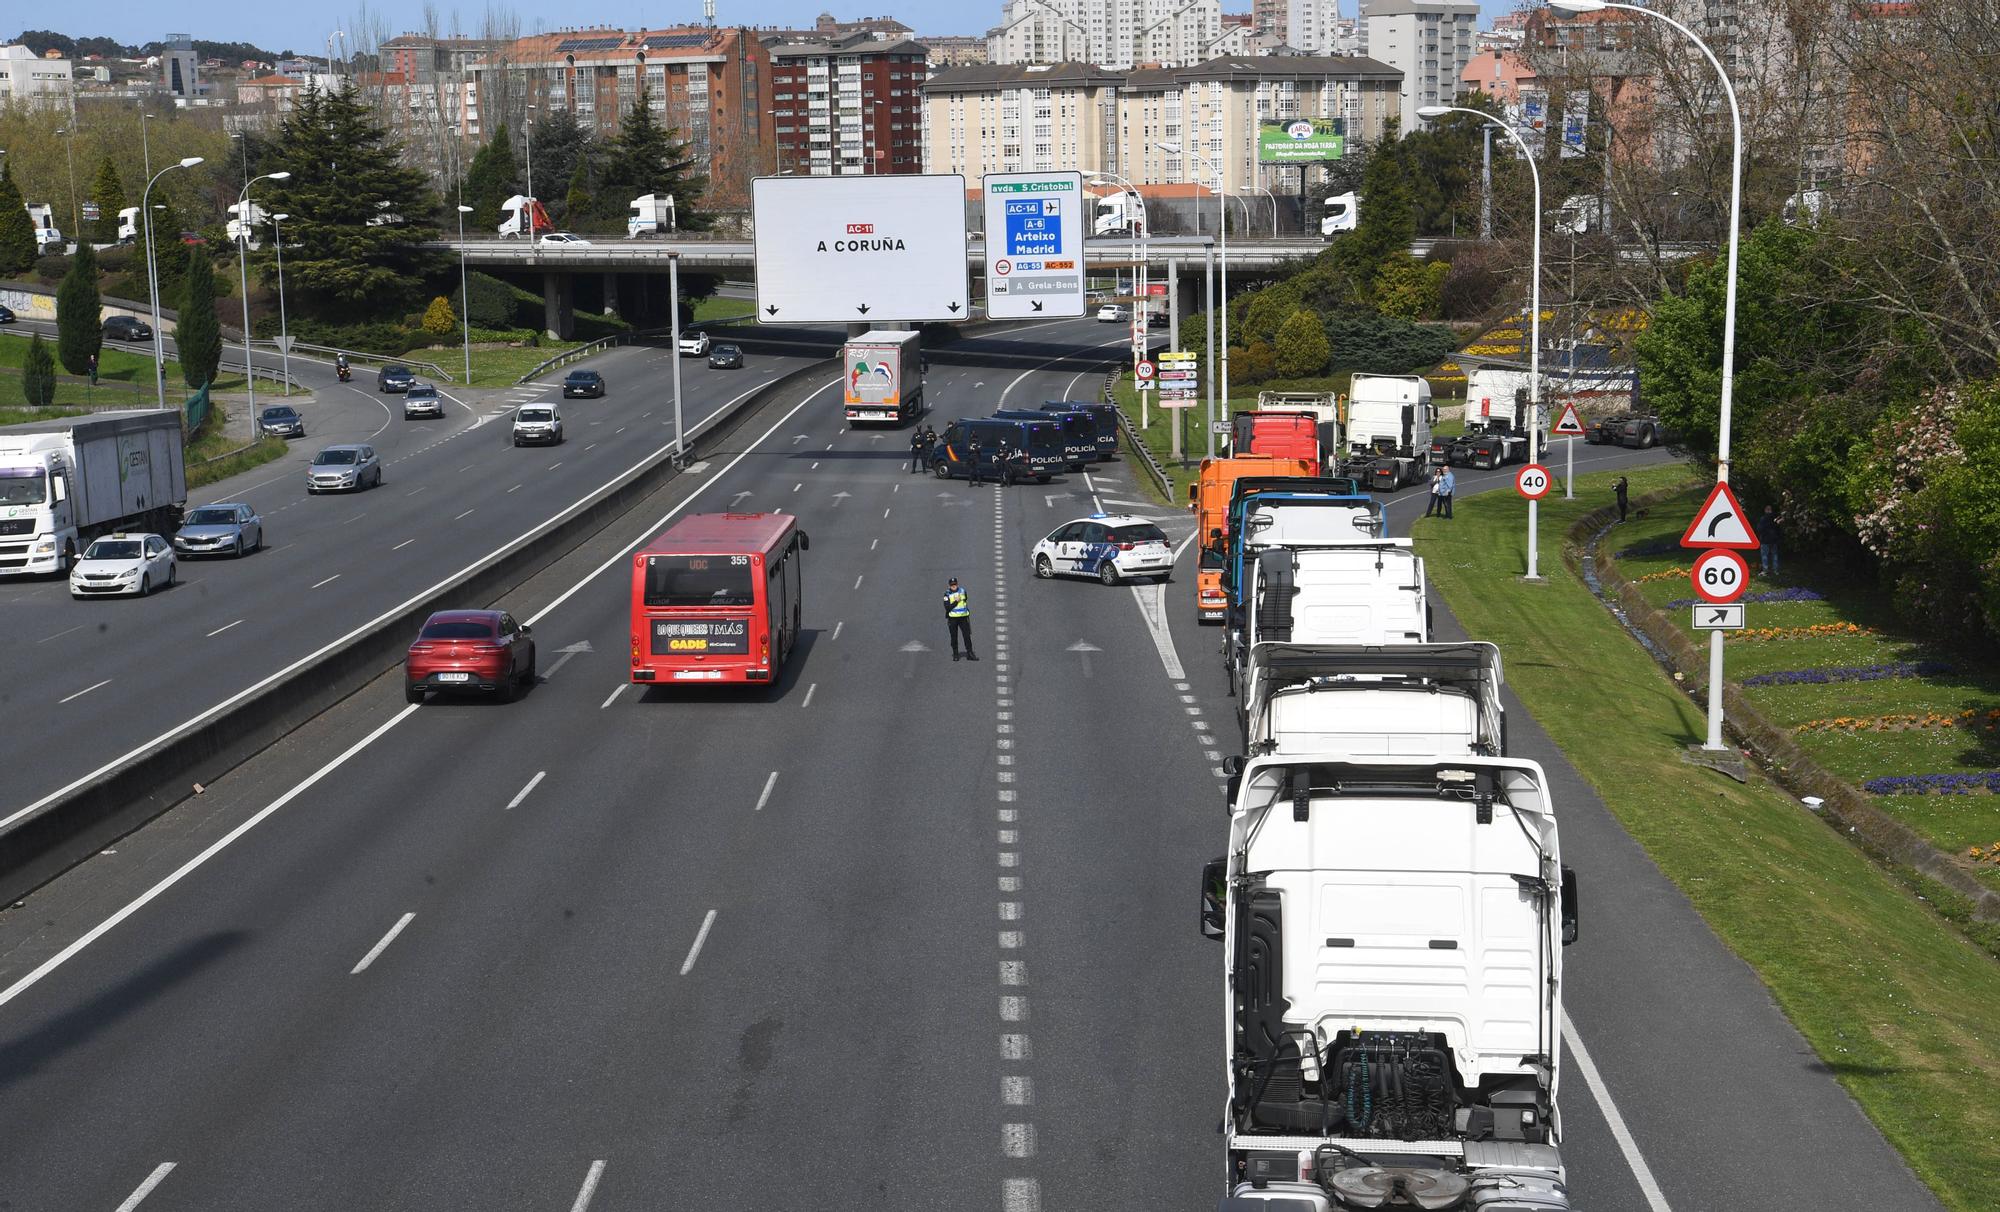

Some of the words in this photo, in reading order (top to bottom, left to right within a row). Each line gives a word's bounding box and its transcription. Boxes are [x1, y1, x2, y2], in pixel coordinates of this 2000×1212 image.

[1291, 124, 1311, 134] LARSA
[992, 184, 1017, 192] avda.
[1009, 204, 1037, 213] AC-14
[848, 224, 873, 233] AC-11
[1026, 220, 1043, 228] A-6
[1015, 231, 1056, 242] Arteixo
[817, 240, 828, 252] A
[834, 236, 906, 252] CORUÑA
[1016, 244, 1055, 254] Madrid
[1017, 262, 1041, 270] AG-55
[1016, 282, 1023, 290] A
[1140, 366, 1151, 374] 70
[1097, 434, 1115, 442] ICÍA
[1065, 444, 1096, 453] POLICÍA
[1030, 455, 1063, 464] POLICÍA
[1523, 476, 1544, 487] 40
[730, 556, 748, 565] 355
[1704, 567, 1736, 585] 60
[657, 624, 666, 635] LO
[666, 624, 681, 637] QUE
[714, 622, 744, 635] MÁS
[670, 639, 707, 650] GADIS
